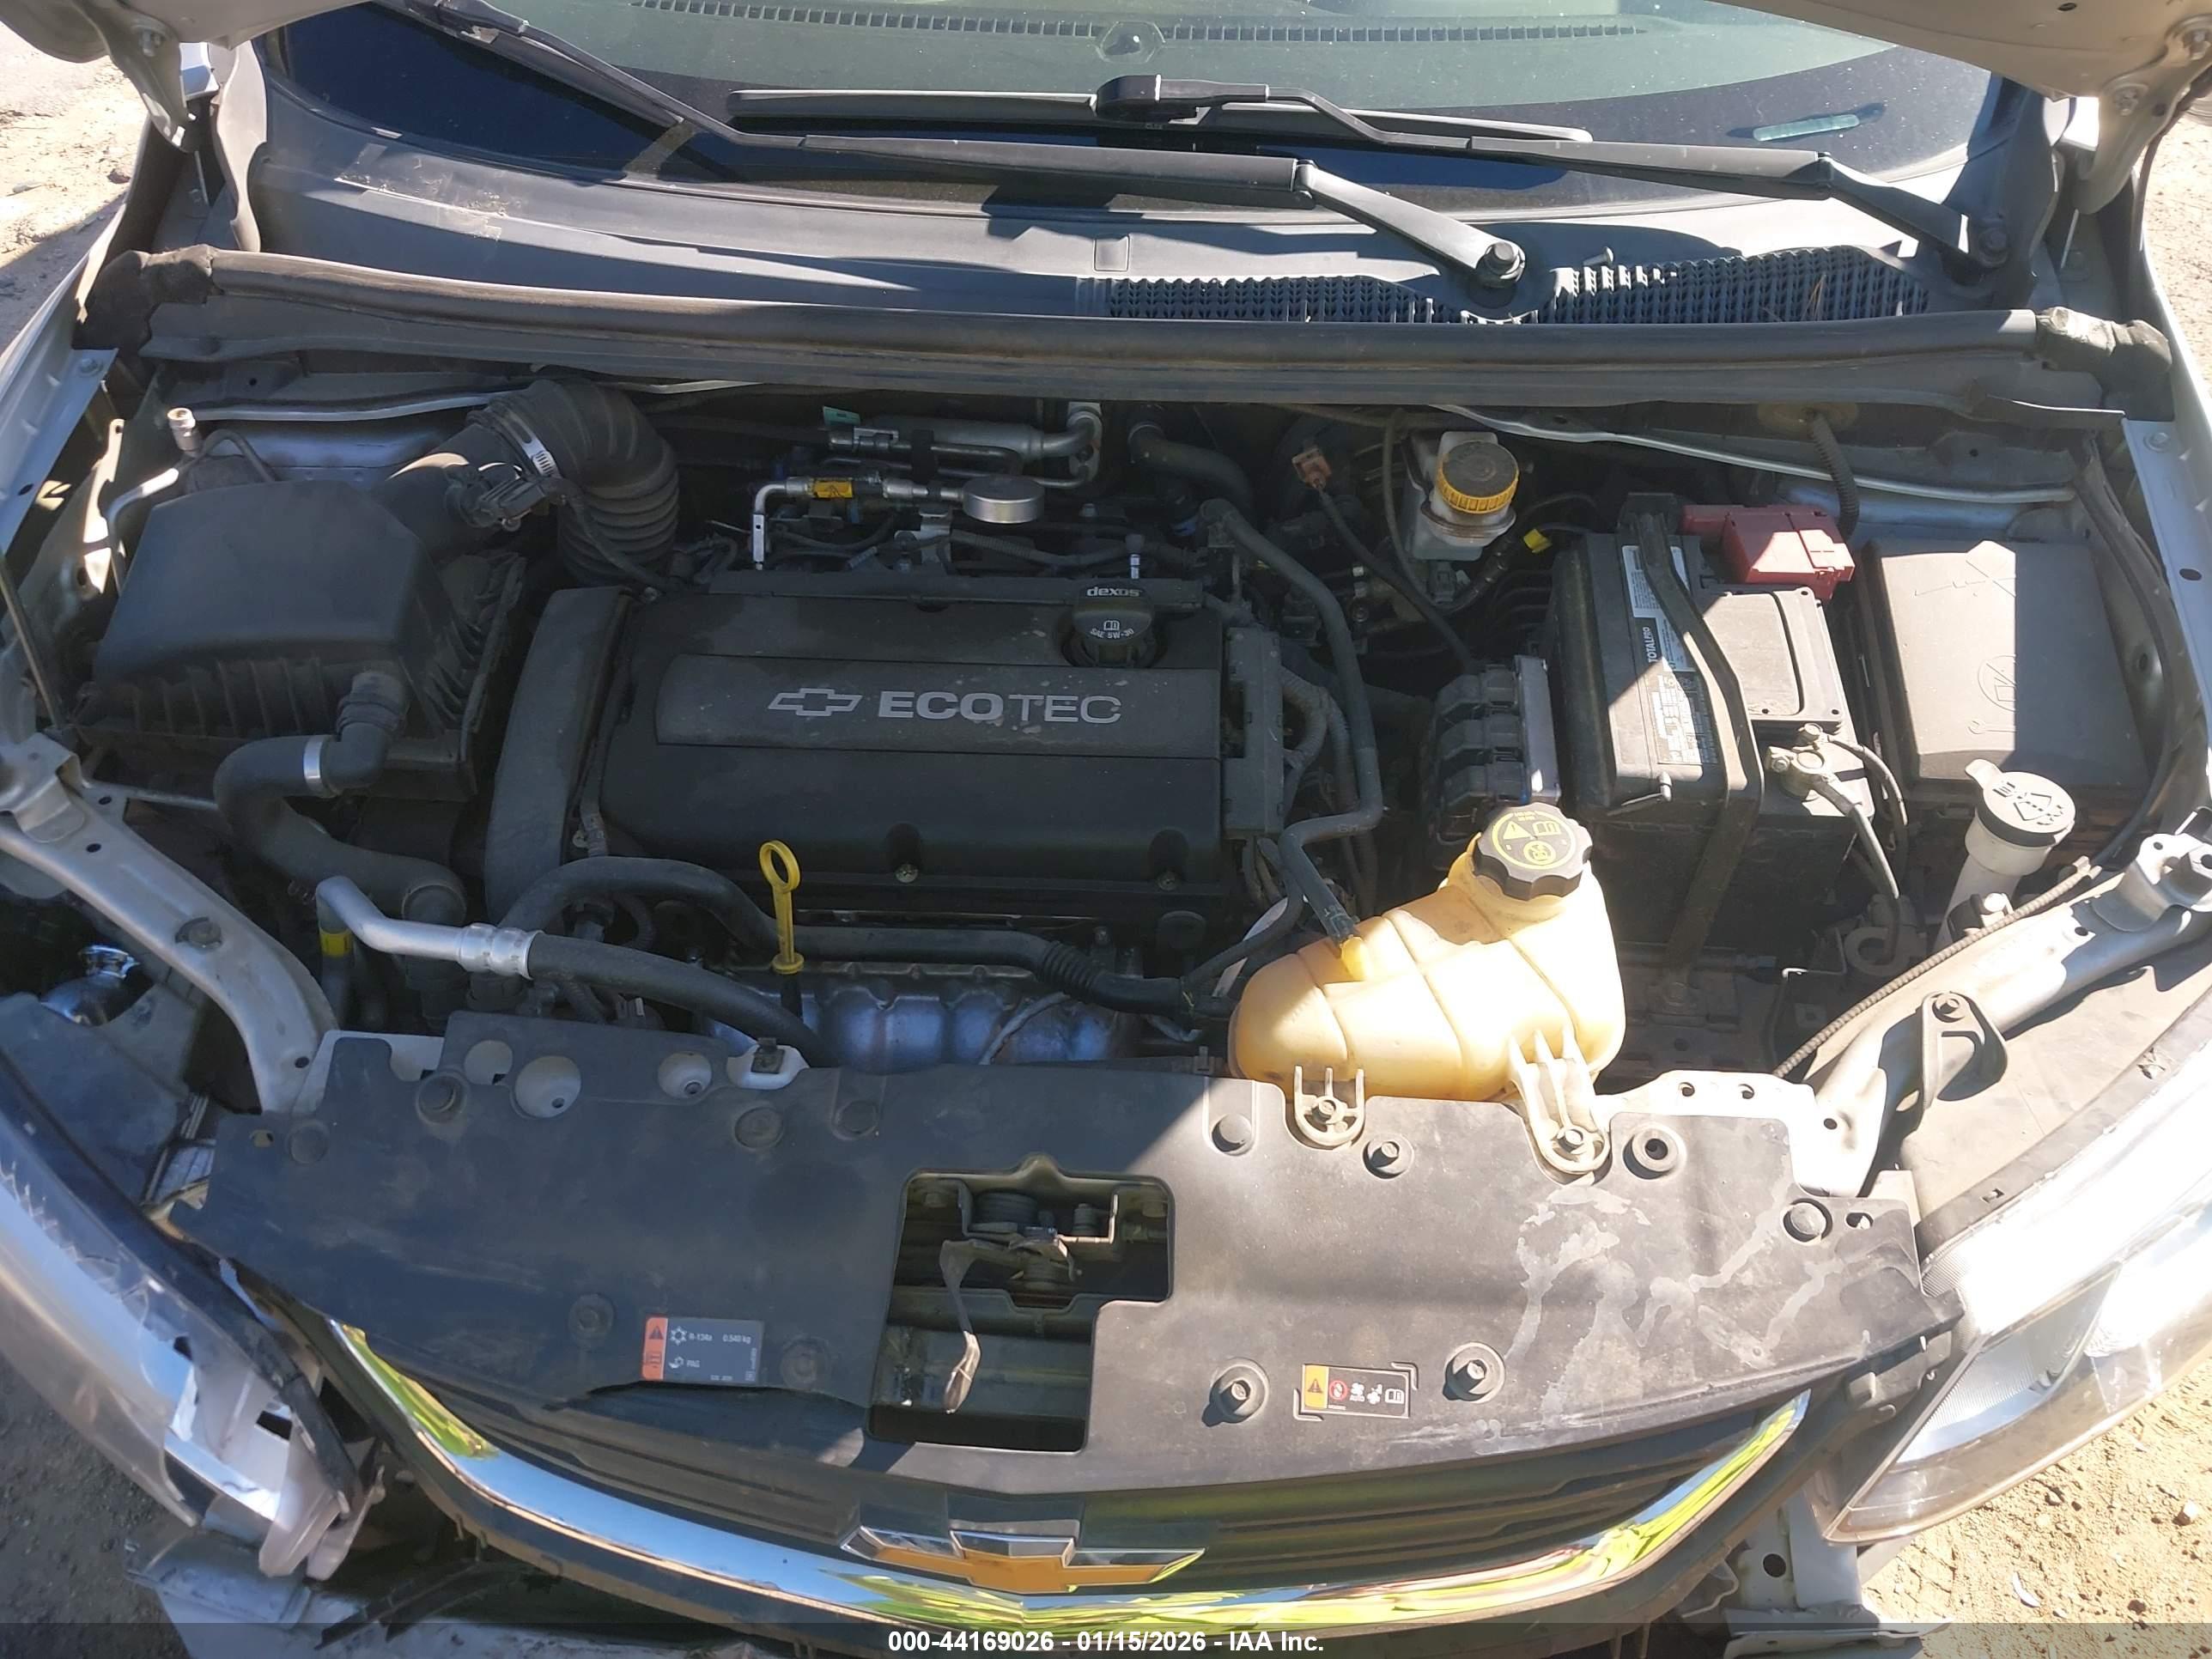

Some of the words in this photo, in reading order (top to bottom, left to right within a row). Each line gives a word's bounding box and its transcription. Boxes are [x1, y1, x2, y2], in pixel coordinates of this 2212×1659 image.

[1086, 586, 1141, 597] dexos
[1090, 628, 1105, 639] SAE
[1107, 628, 1135, 640] 5W-30
[878, 690, 1123, 725] ECOTEC
[686, 1359, 701, 1368] PAG
